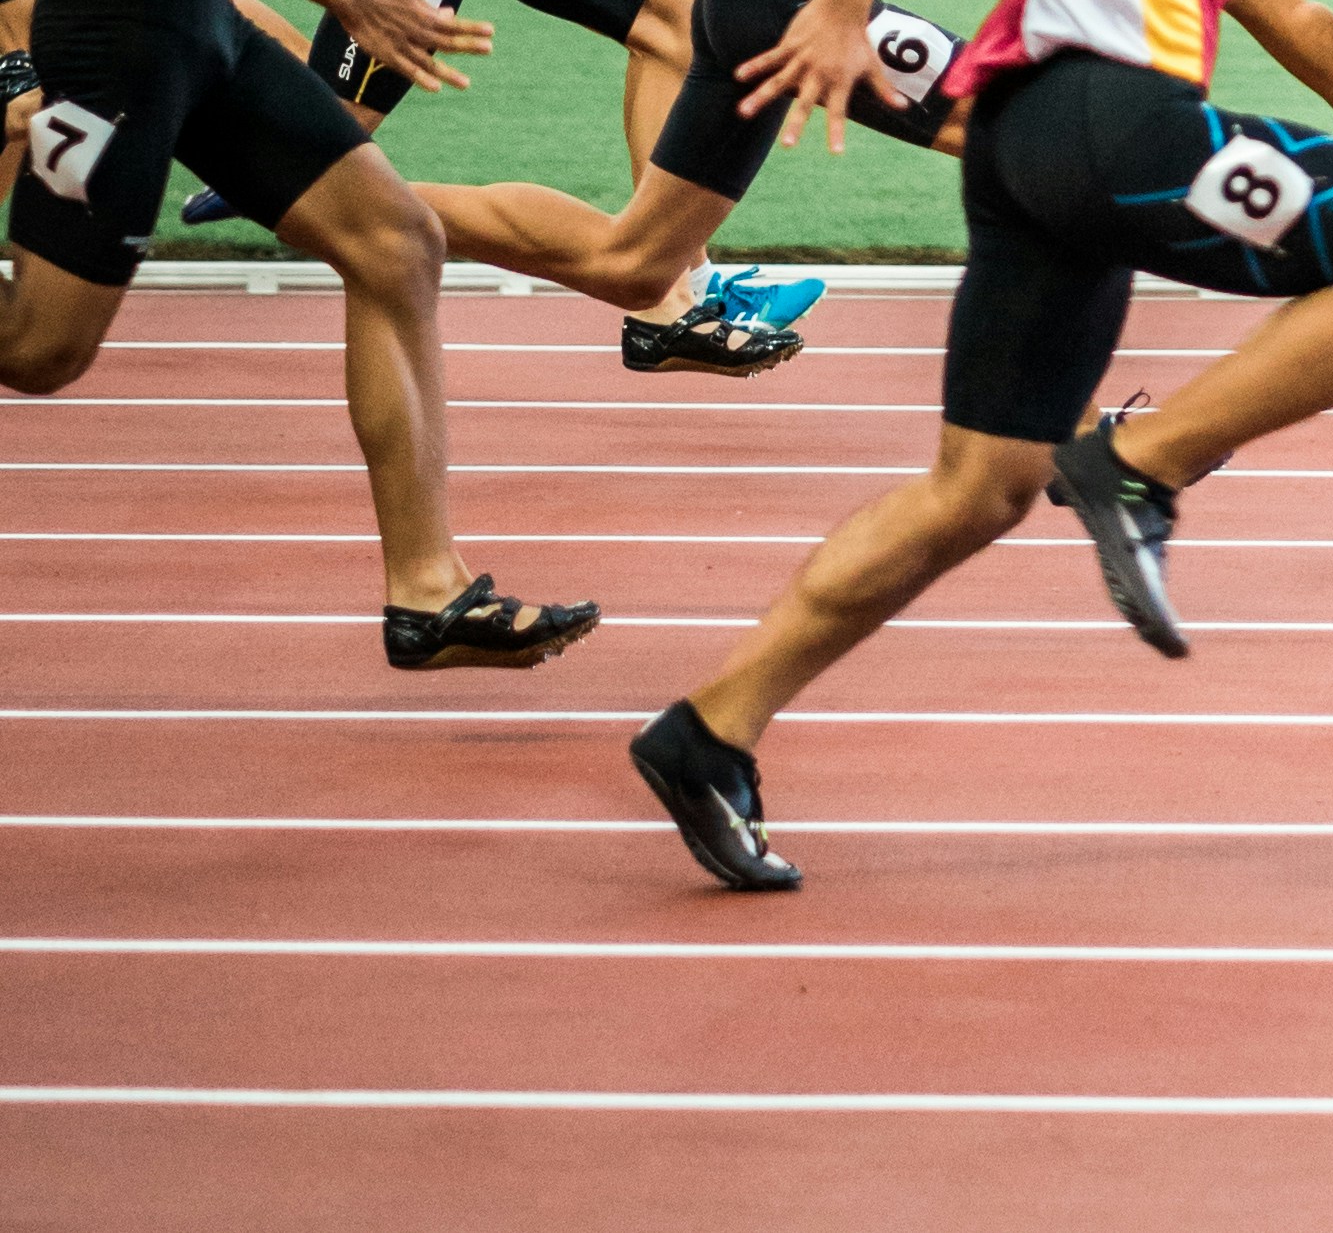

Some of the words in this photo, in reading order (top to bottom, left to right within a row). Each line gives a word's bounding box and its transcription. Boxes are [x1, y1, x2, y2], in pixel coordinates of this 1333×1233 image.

[877, 29, 930, 74] 6
[46, 116, 89, 173] 7
[1222, 163, 1280, 219] 8
